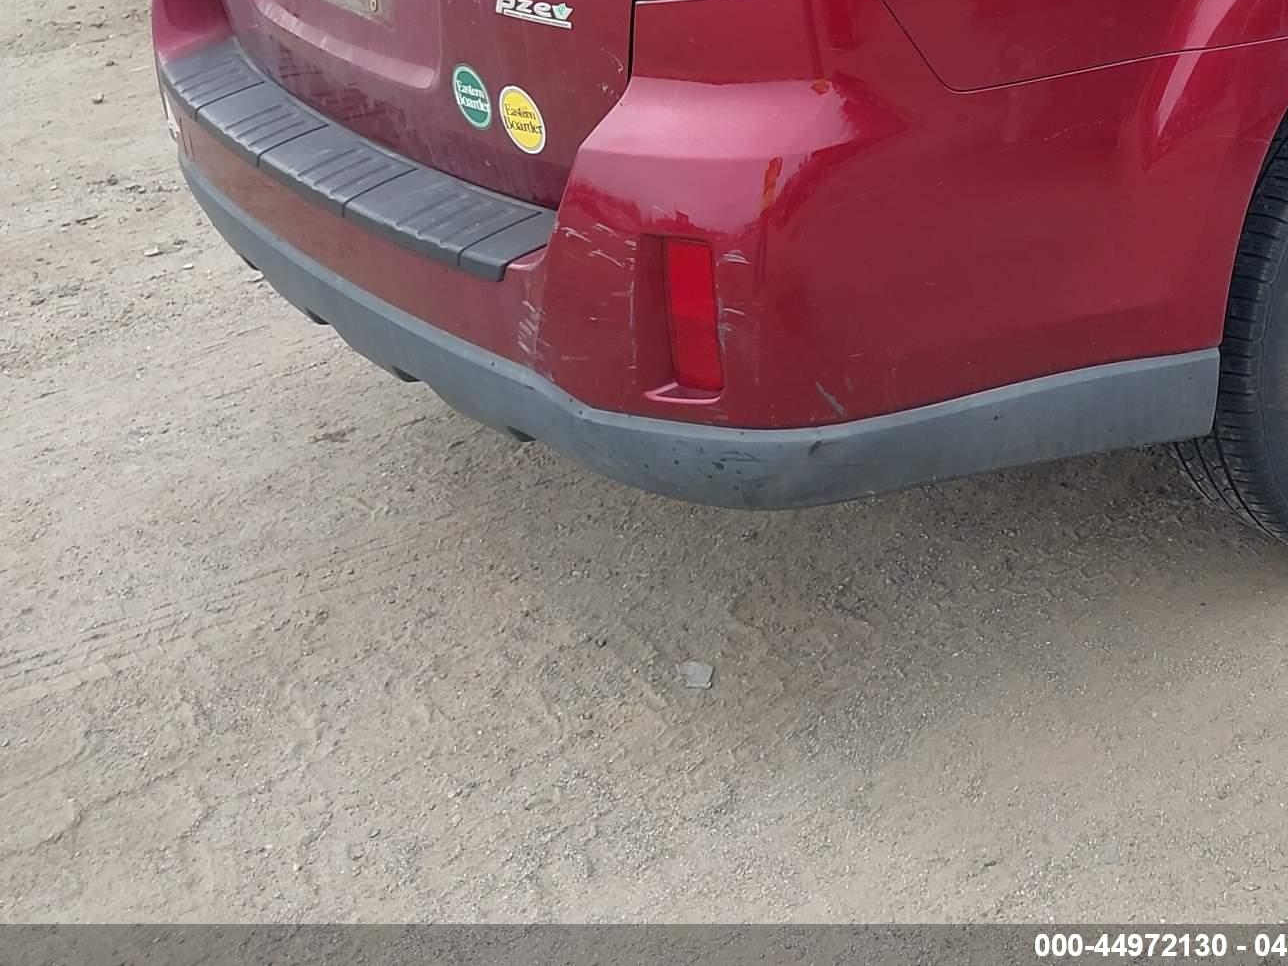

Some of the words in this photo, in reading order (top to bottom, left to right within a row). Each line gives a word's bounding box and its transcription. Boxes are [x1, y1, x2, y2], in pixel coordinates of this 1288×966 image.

[456, 80, 485, 99] Eastern
[457, 92, 491, 112] Boarder
[504, 103, 537, 121] Eastern
[503, 115, 543, 135] Boarder
